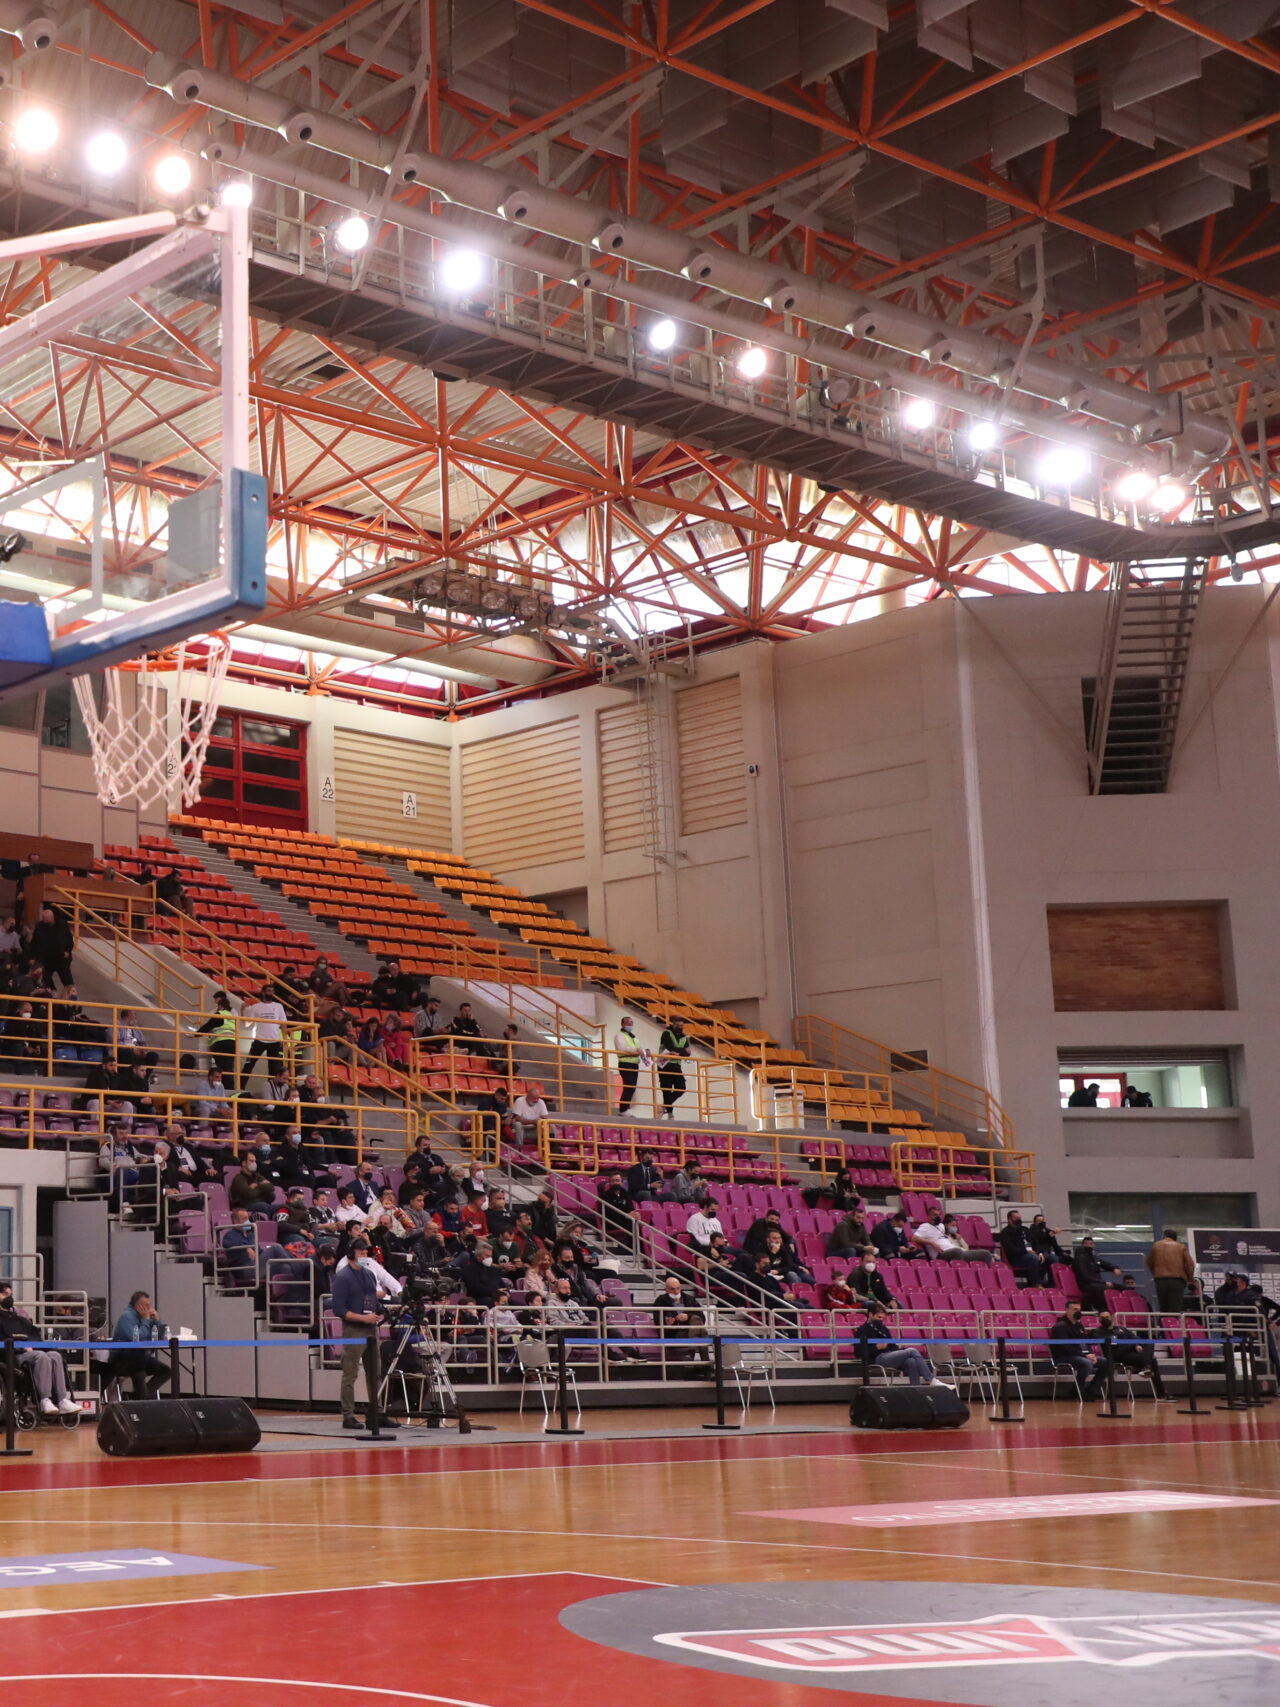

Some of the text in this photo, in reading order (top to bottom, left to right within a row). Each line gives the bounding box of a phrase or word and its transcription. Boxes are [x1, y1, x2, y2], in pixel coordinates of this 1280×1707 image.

[324, 777, 332, 788] A
[322, 788, 334, 799] 22
[406, 795, 414, 805] A
[405, 805, 416, 816] 21
